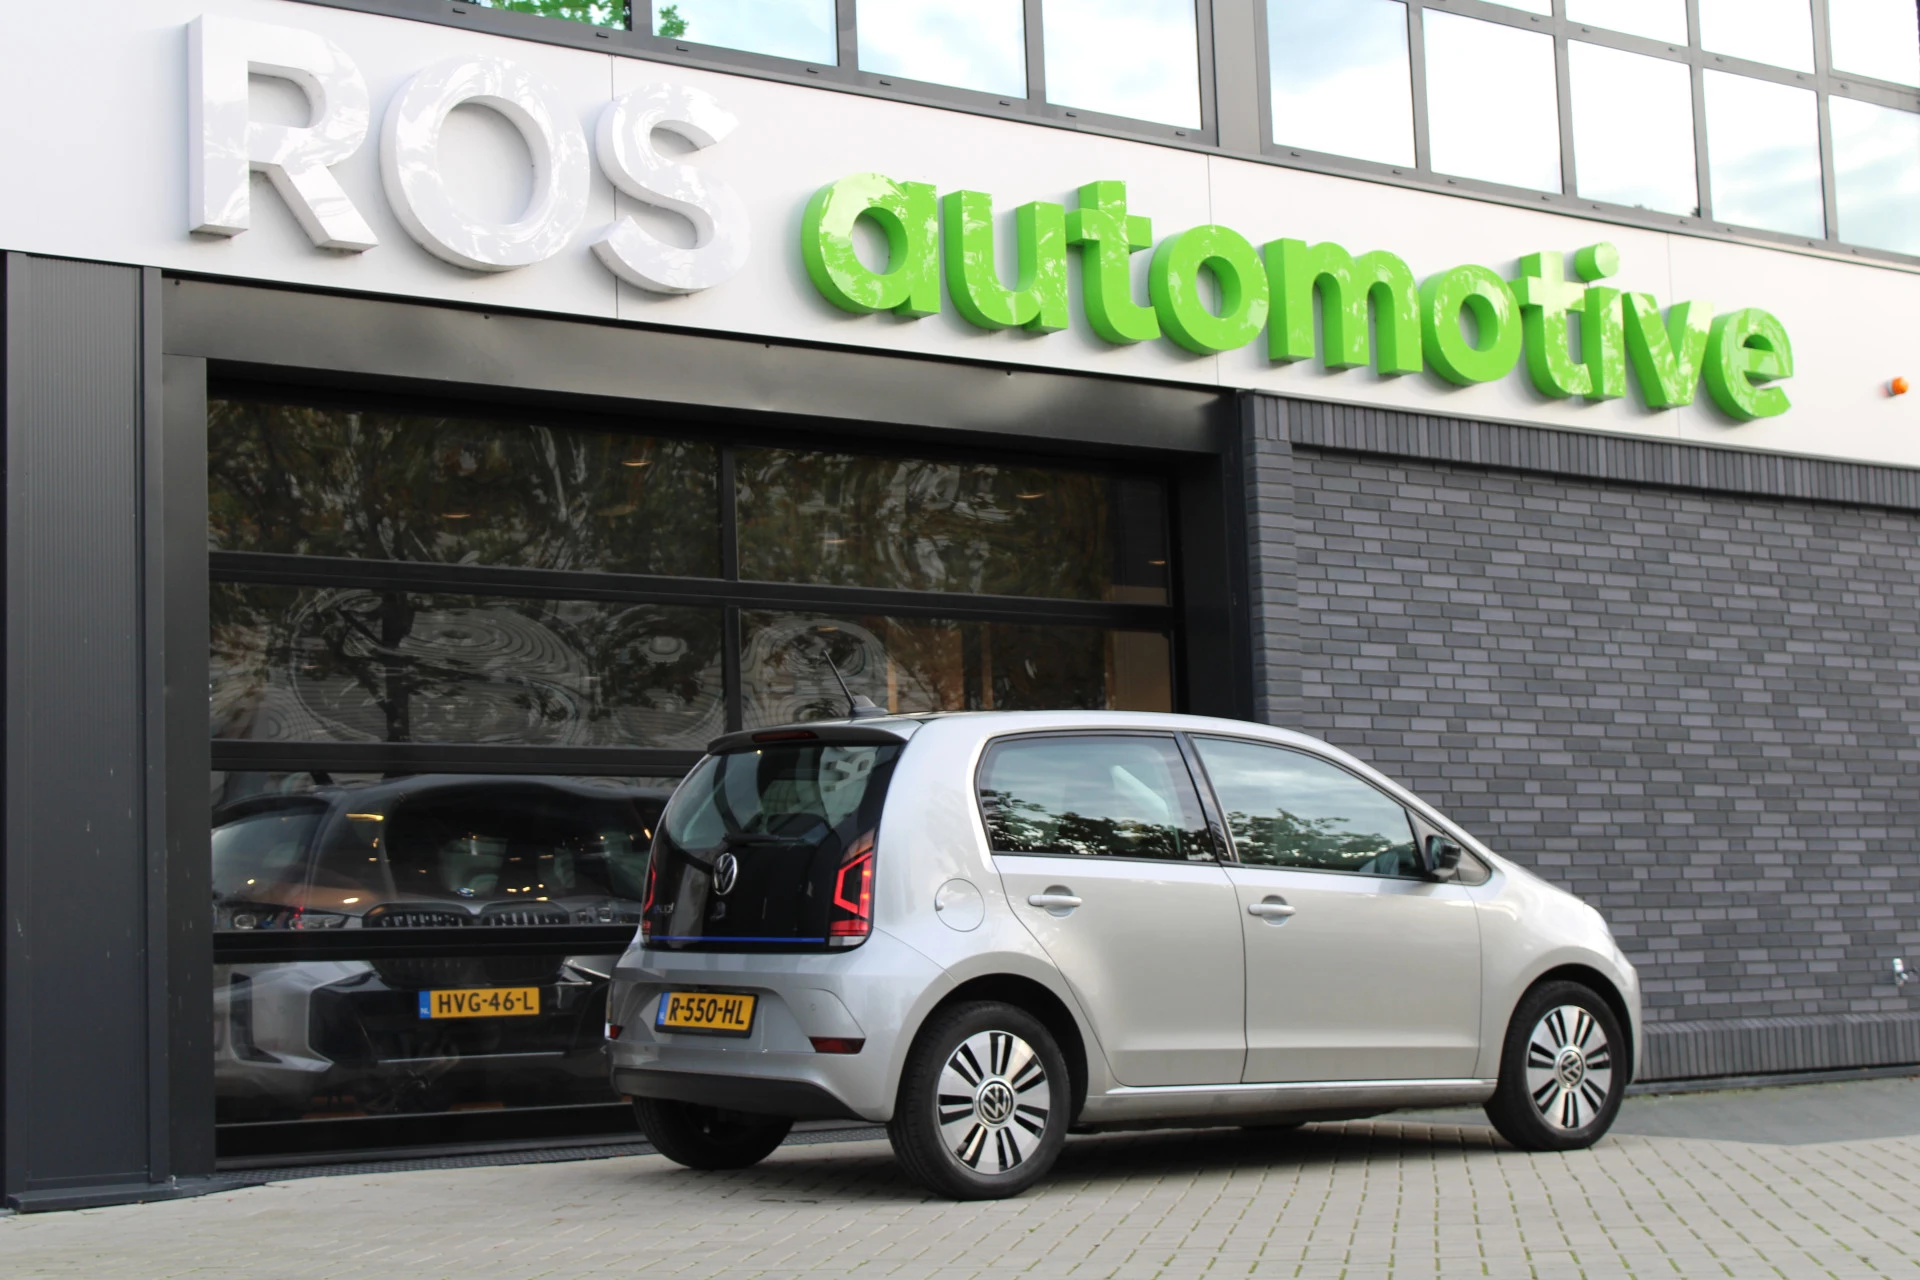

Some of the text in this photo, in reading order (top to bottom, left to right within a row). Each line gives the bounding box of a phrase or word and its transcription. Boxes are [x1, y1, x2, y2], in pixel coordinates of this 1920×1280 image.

[188, 14, 752, 295] ROS
[802, 171, 1794, 424] automotive
[438, 991, 535, 1014] HVG-46-L
[668, 997, 745, 1025] R-550-HL
